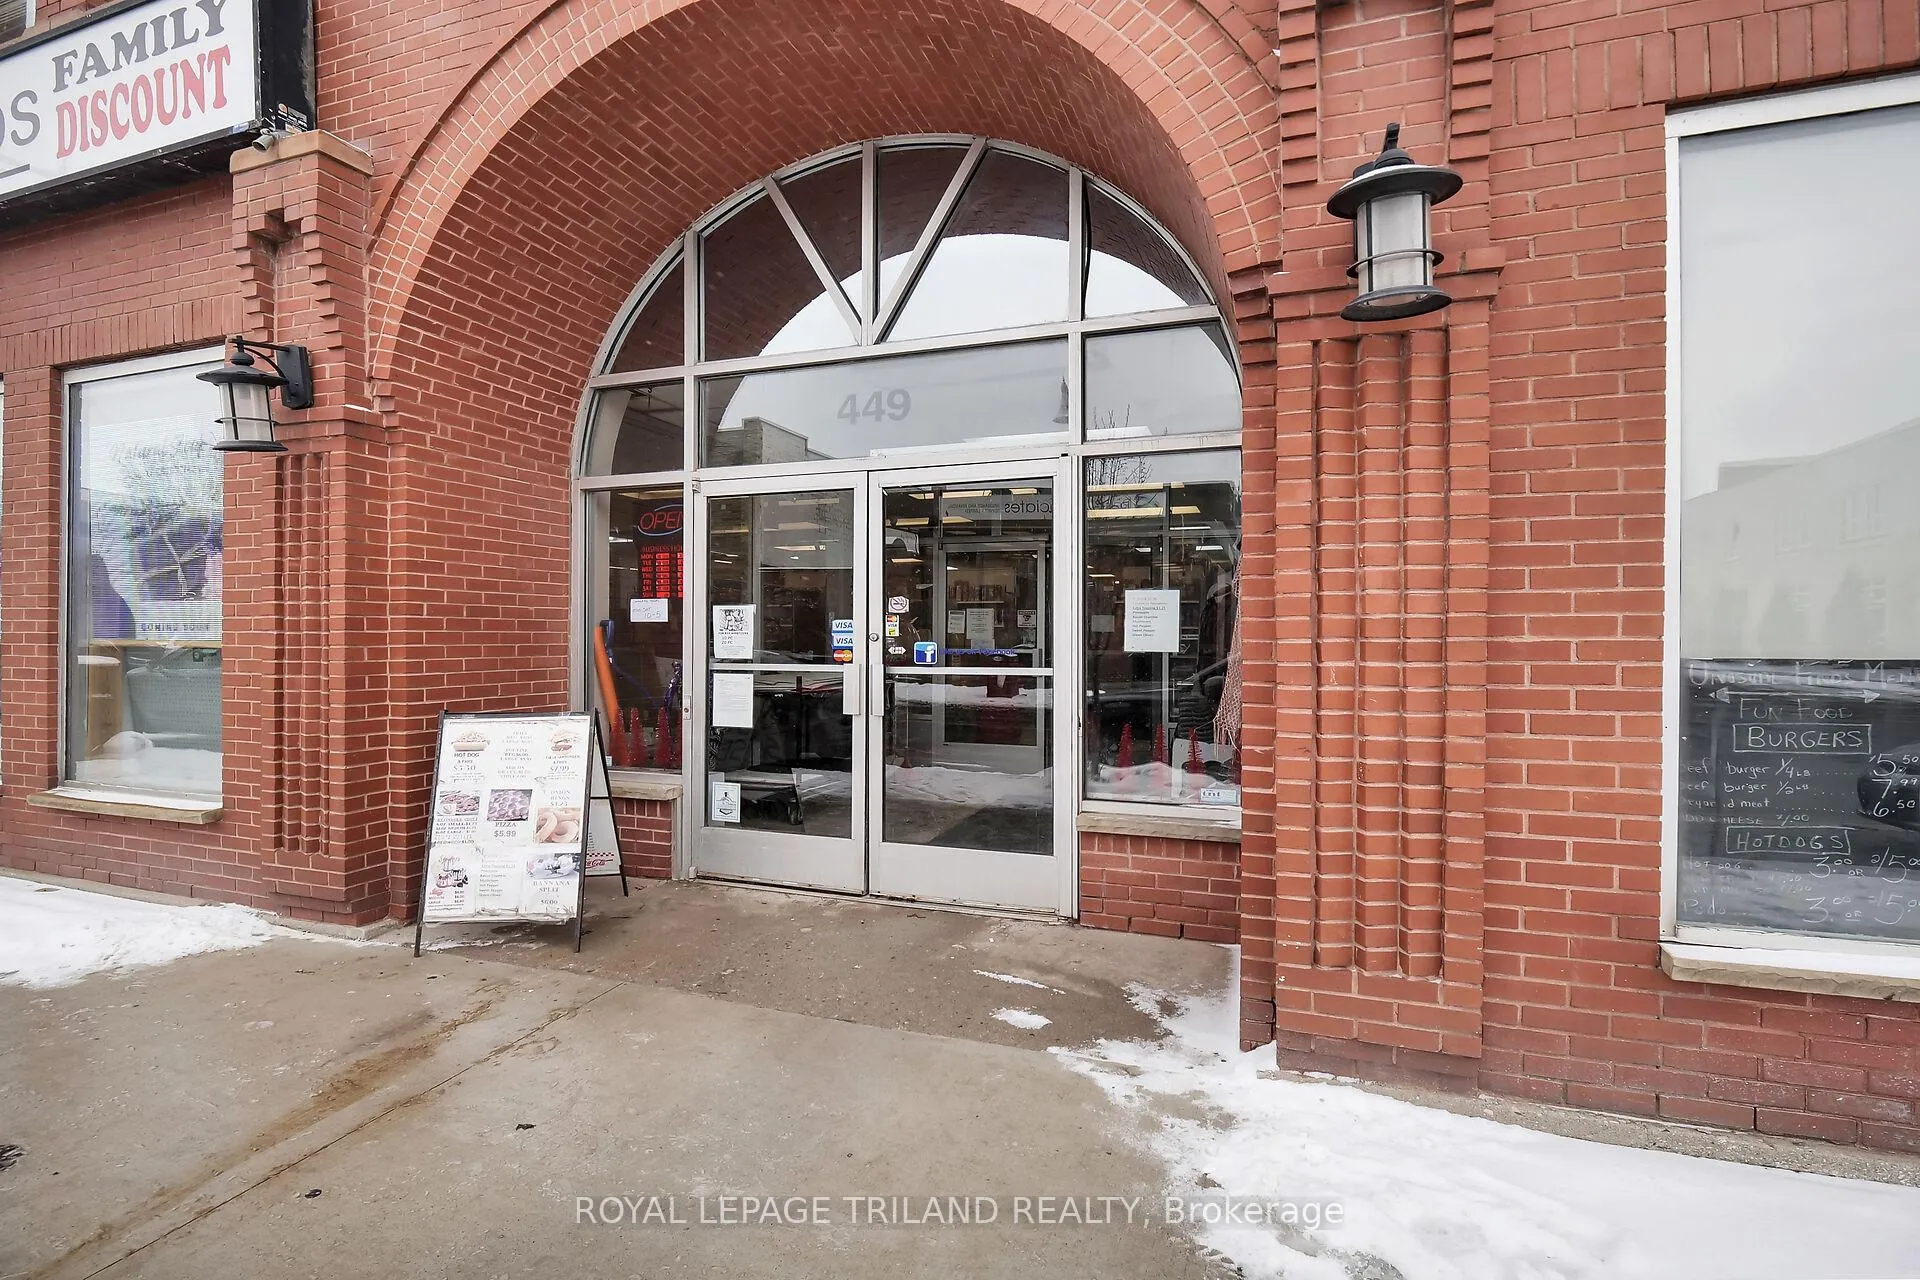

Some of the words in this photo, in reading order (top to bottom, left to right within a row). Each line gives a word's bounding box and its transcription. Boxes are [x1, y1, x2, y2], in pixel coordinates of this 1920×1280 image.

[52, 0, 229, 93] FAMILY
[56, 45, 231, 159] DISCOUNT
[0, 90, 40, 147] S
[837, 388, 912, 425] 449
[1748, 726, 1863, 749] BURGERS
[1726, 761, 1771, 779] burger
[1723, 782, 1768, 793] burger
[1740, 797, 1770, 808] meat
[493, 830, 517, 838] $5.99
